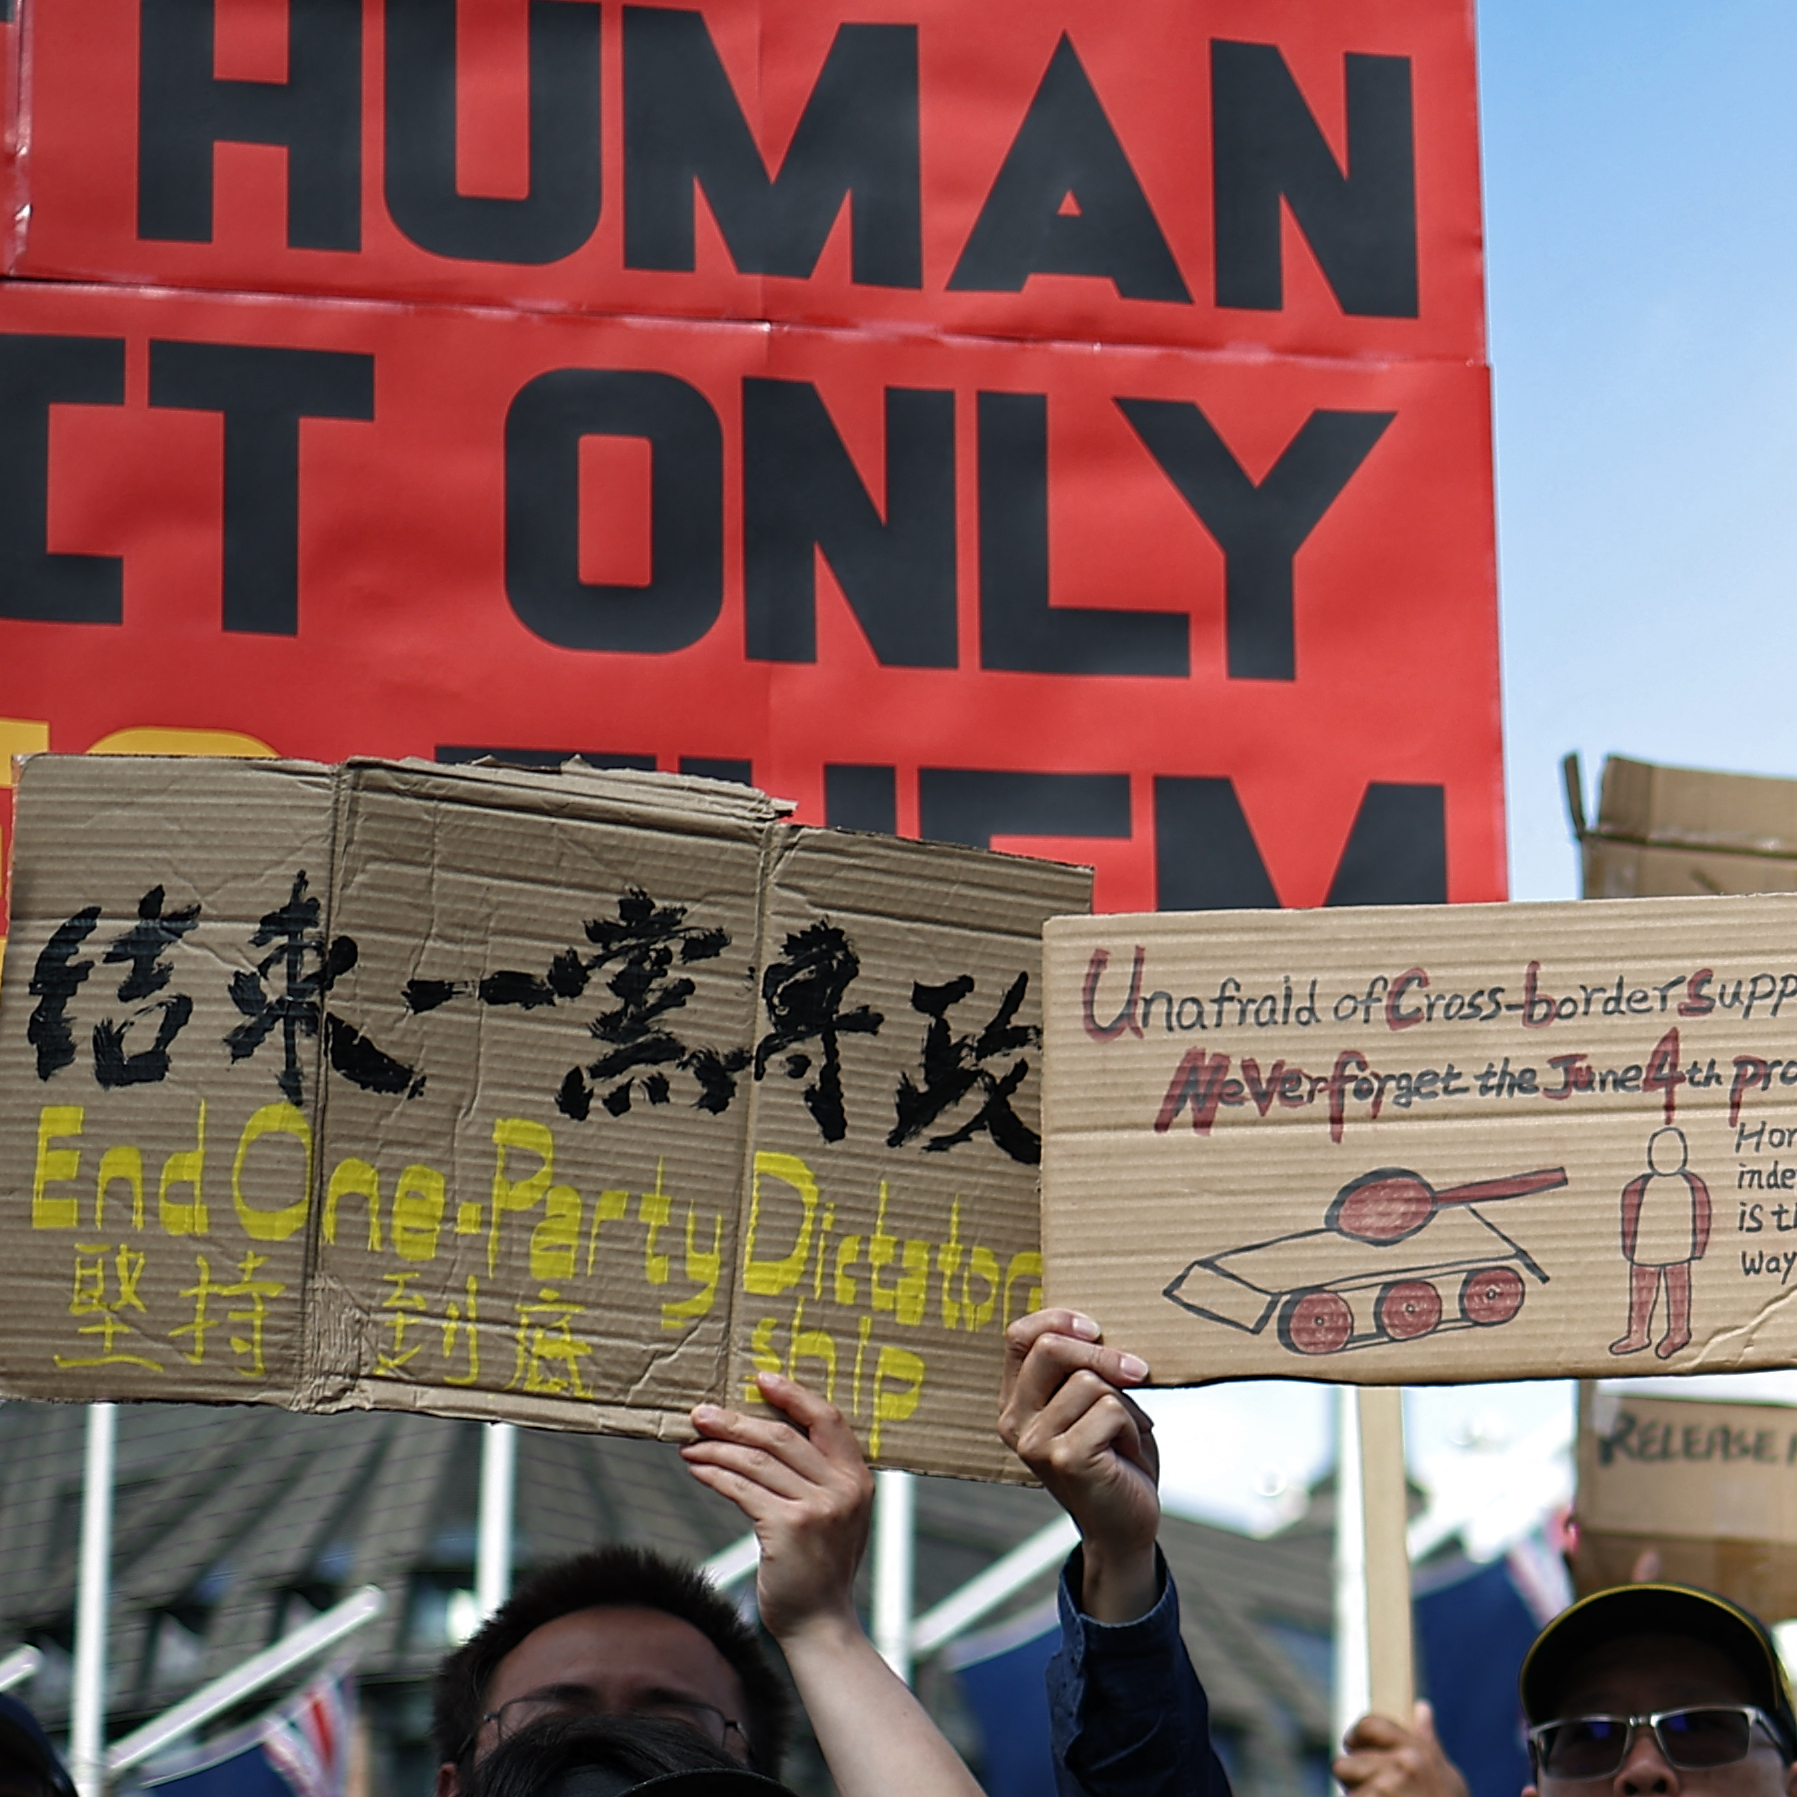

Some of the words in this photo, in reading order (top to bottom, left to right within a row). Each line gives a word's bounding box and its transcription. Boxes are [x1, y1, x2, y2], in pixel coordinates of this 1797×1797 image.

[136, 0, 1420, 318] HUMAN
[503, 366, 1398, 682] ONLY
[1082, 945, 1321, 1042] Unafraid
[1333, 975, 1388, 1028] of
[1320, 1050, 1470, 1144] forget
[1474, 1057, 1540, 1098] the
[1542, 1053, 1641, 1100] June
[1642, 1026, 1723, 1125] 4th
[31, 1098, 207, 1237] End
[1598, 1410, 1780, 1467] RELEASE
